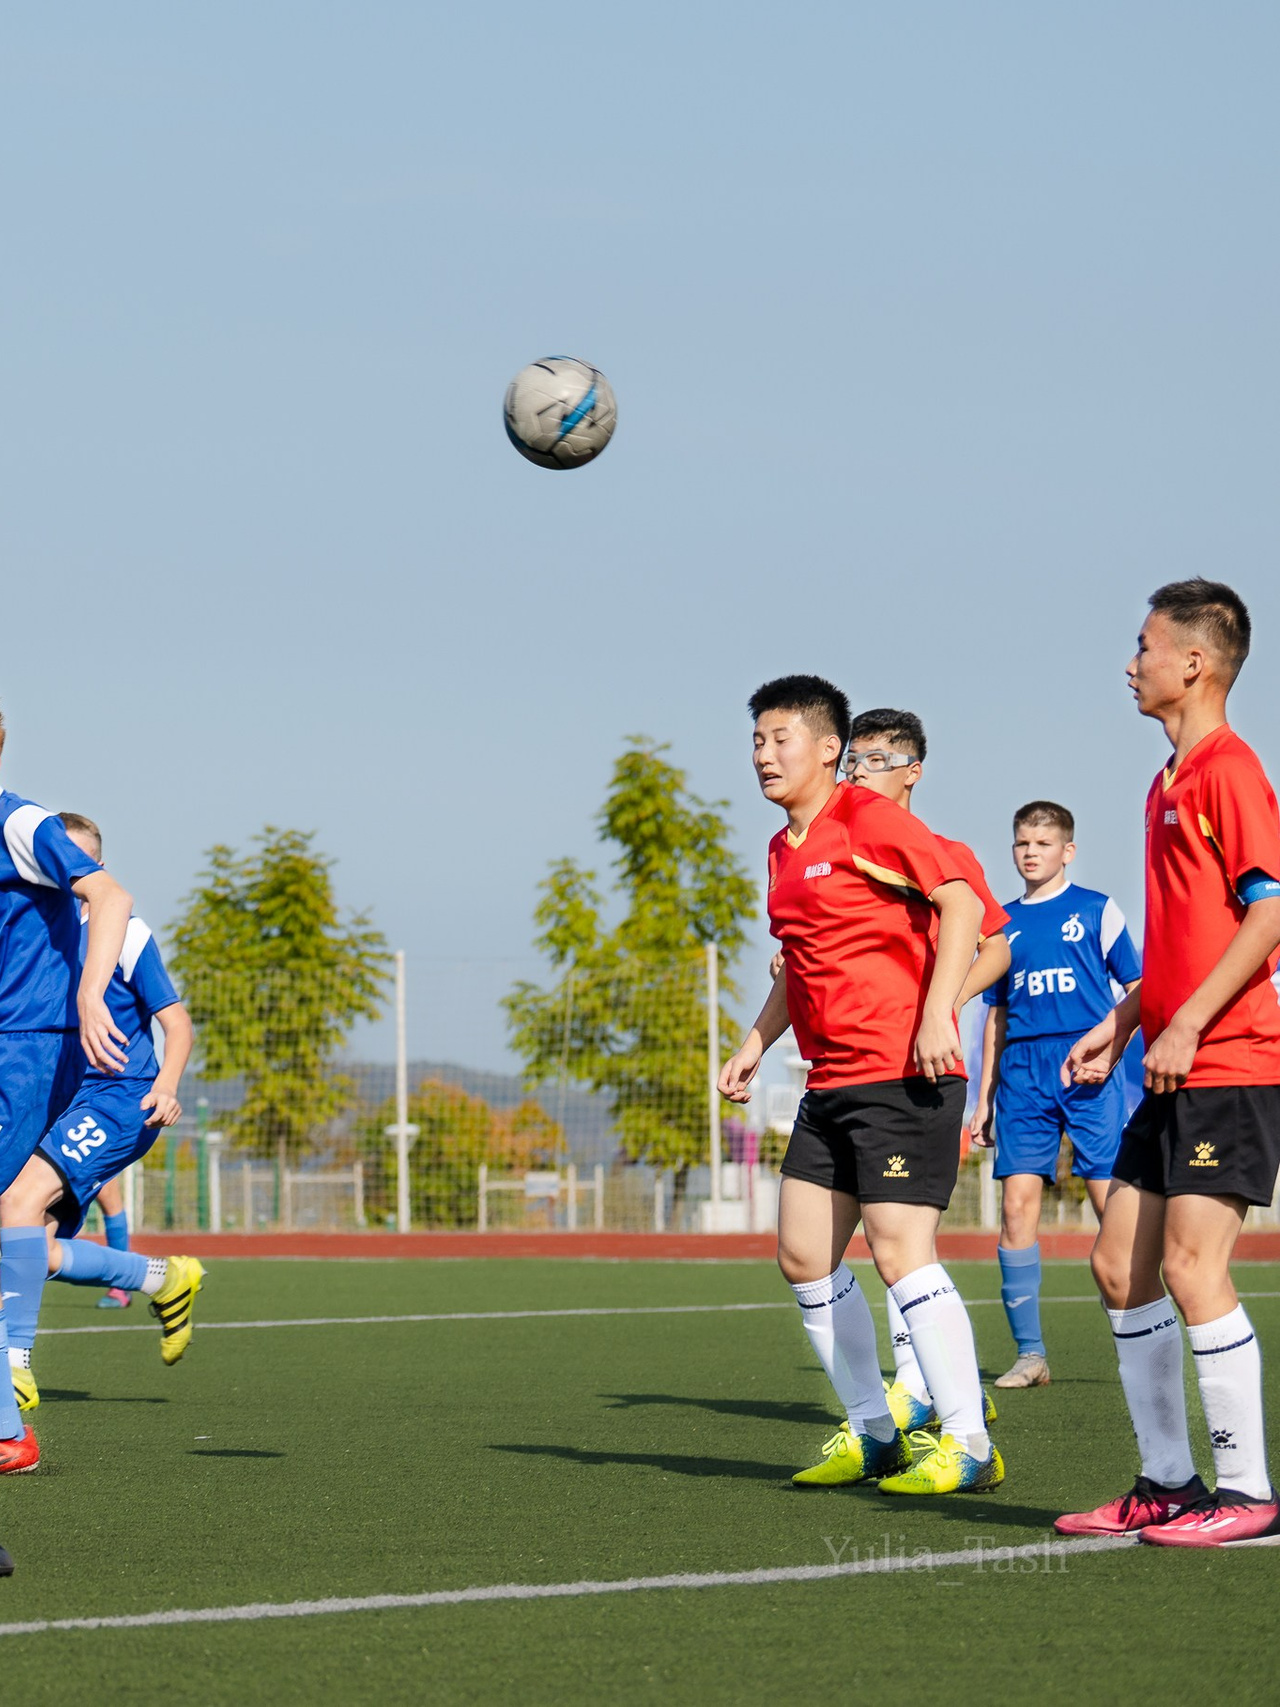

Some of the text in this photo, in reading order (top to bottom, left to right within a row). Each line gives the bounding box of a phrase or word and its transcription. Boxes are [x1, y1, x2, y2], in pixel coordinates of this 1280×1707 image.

[1028, 967, 1077, 997] ВТБ
[67, 1115, 107, 1157] 32
[1189, 1159, 1219, 1167] KELME
[883, 1170, 910, 1178] KELME
